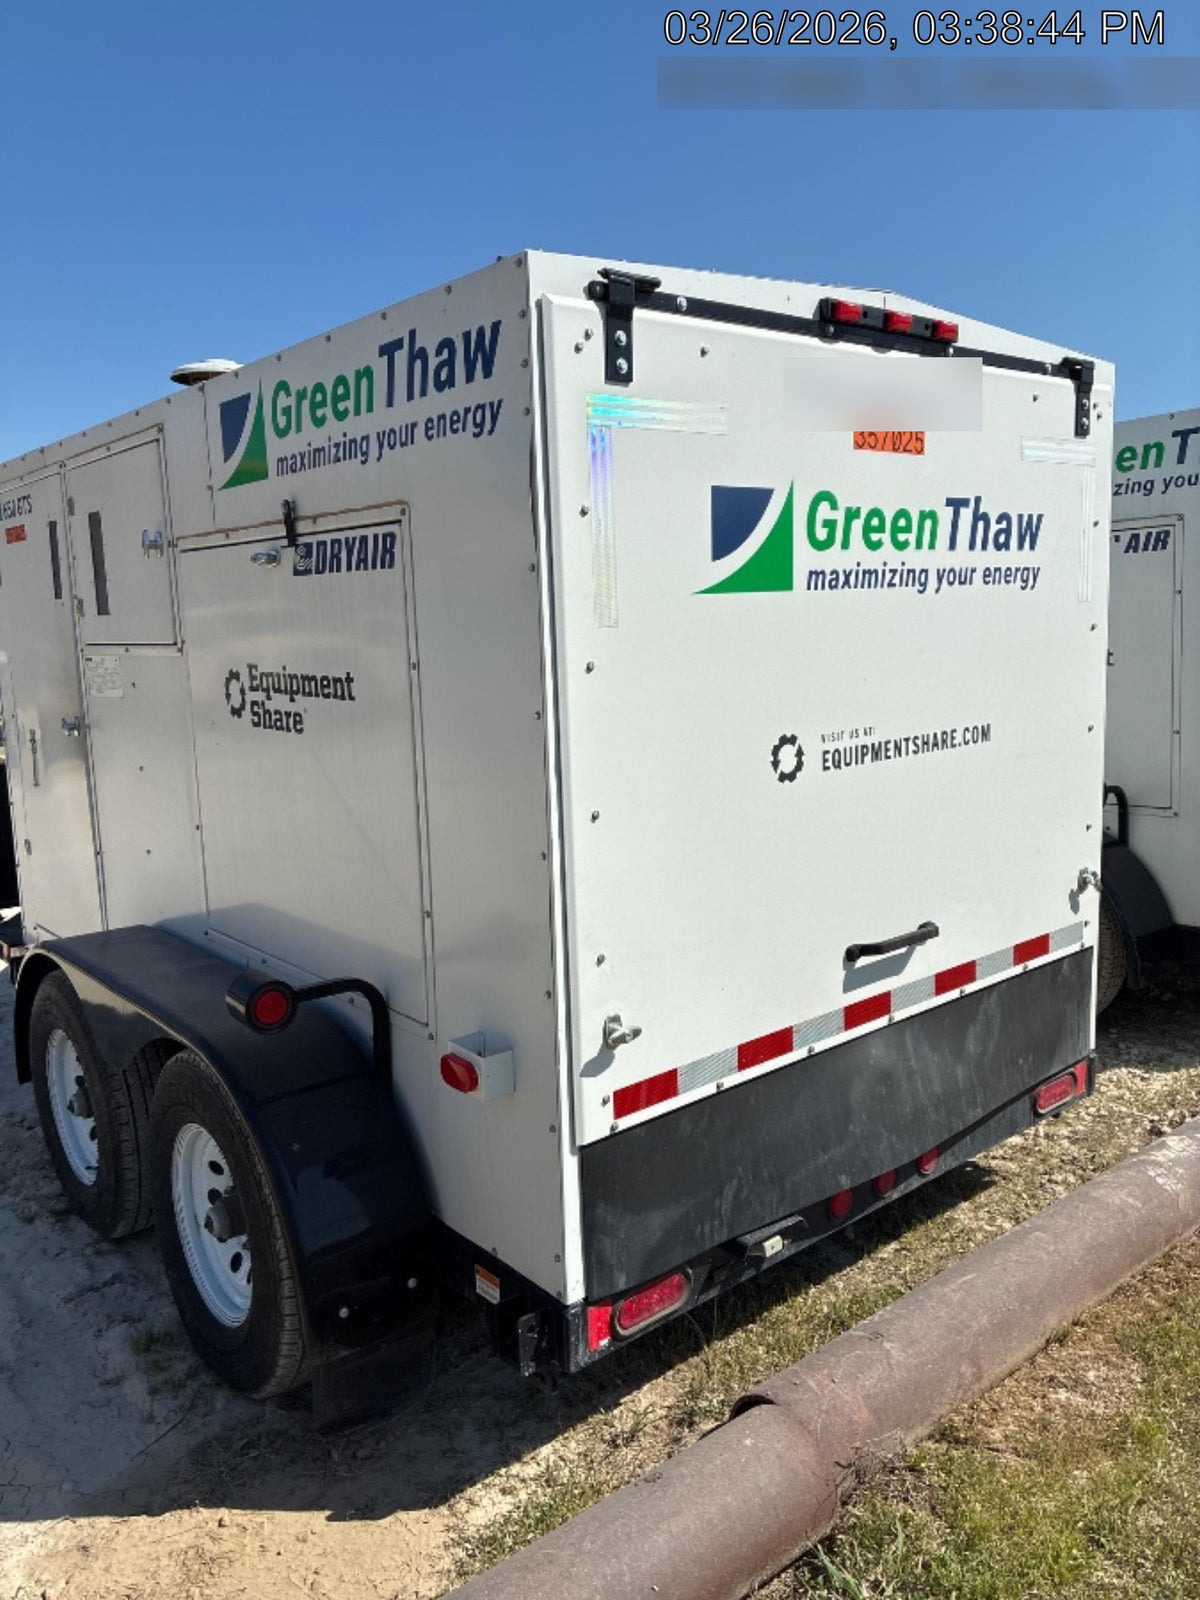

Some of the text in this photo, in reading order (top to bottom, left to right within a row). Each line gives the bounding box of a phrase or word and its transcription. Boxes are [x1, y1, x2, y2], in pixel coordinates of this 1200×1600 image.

[271, 320, 502, 439] GreenThaw
[276, 398, 503, 477] maximizing your energy
[1161, 473, 1200, 495] you
[806, 489, 1044, 552] GreenThaw
[314, 531, 397, 575] DRYAIR
[806, 561, 1041, 594] maximizing your energy
[247, 663, 356, 702] Equipment
[250, 700, 304, 734] Share
[821, 730, 845, 743] VISIT
[849, 728, 859, 740] US
[822, 723, 992, 772] EQUIPMENTSHARE.COM
